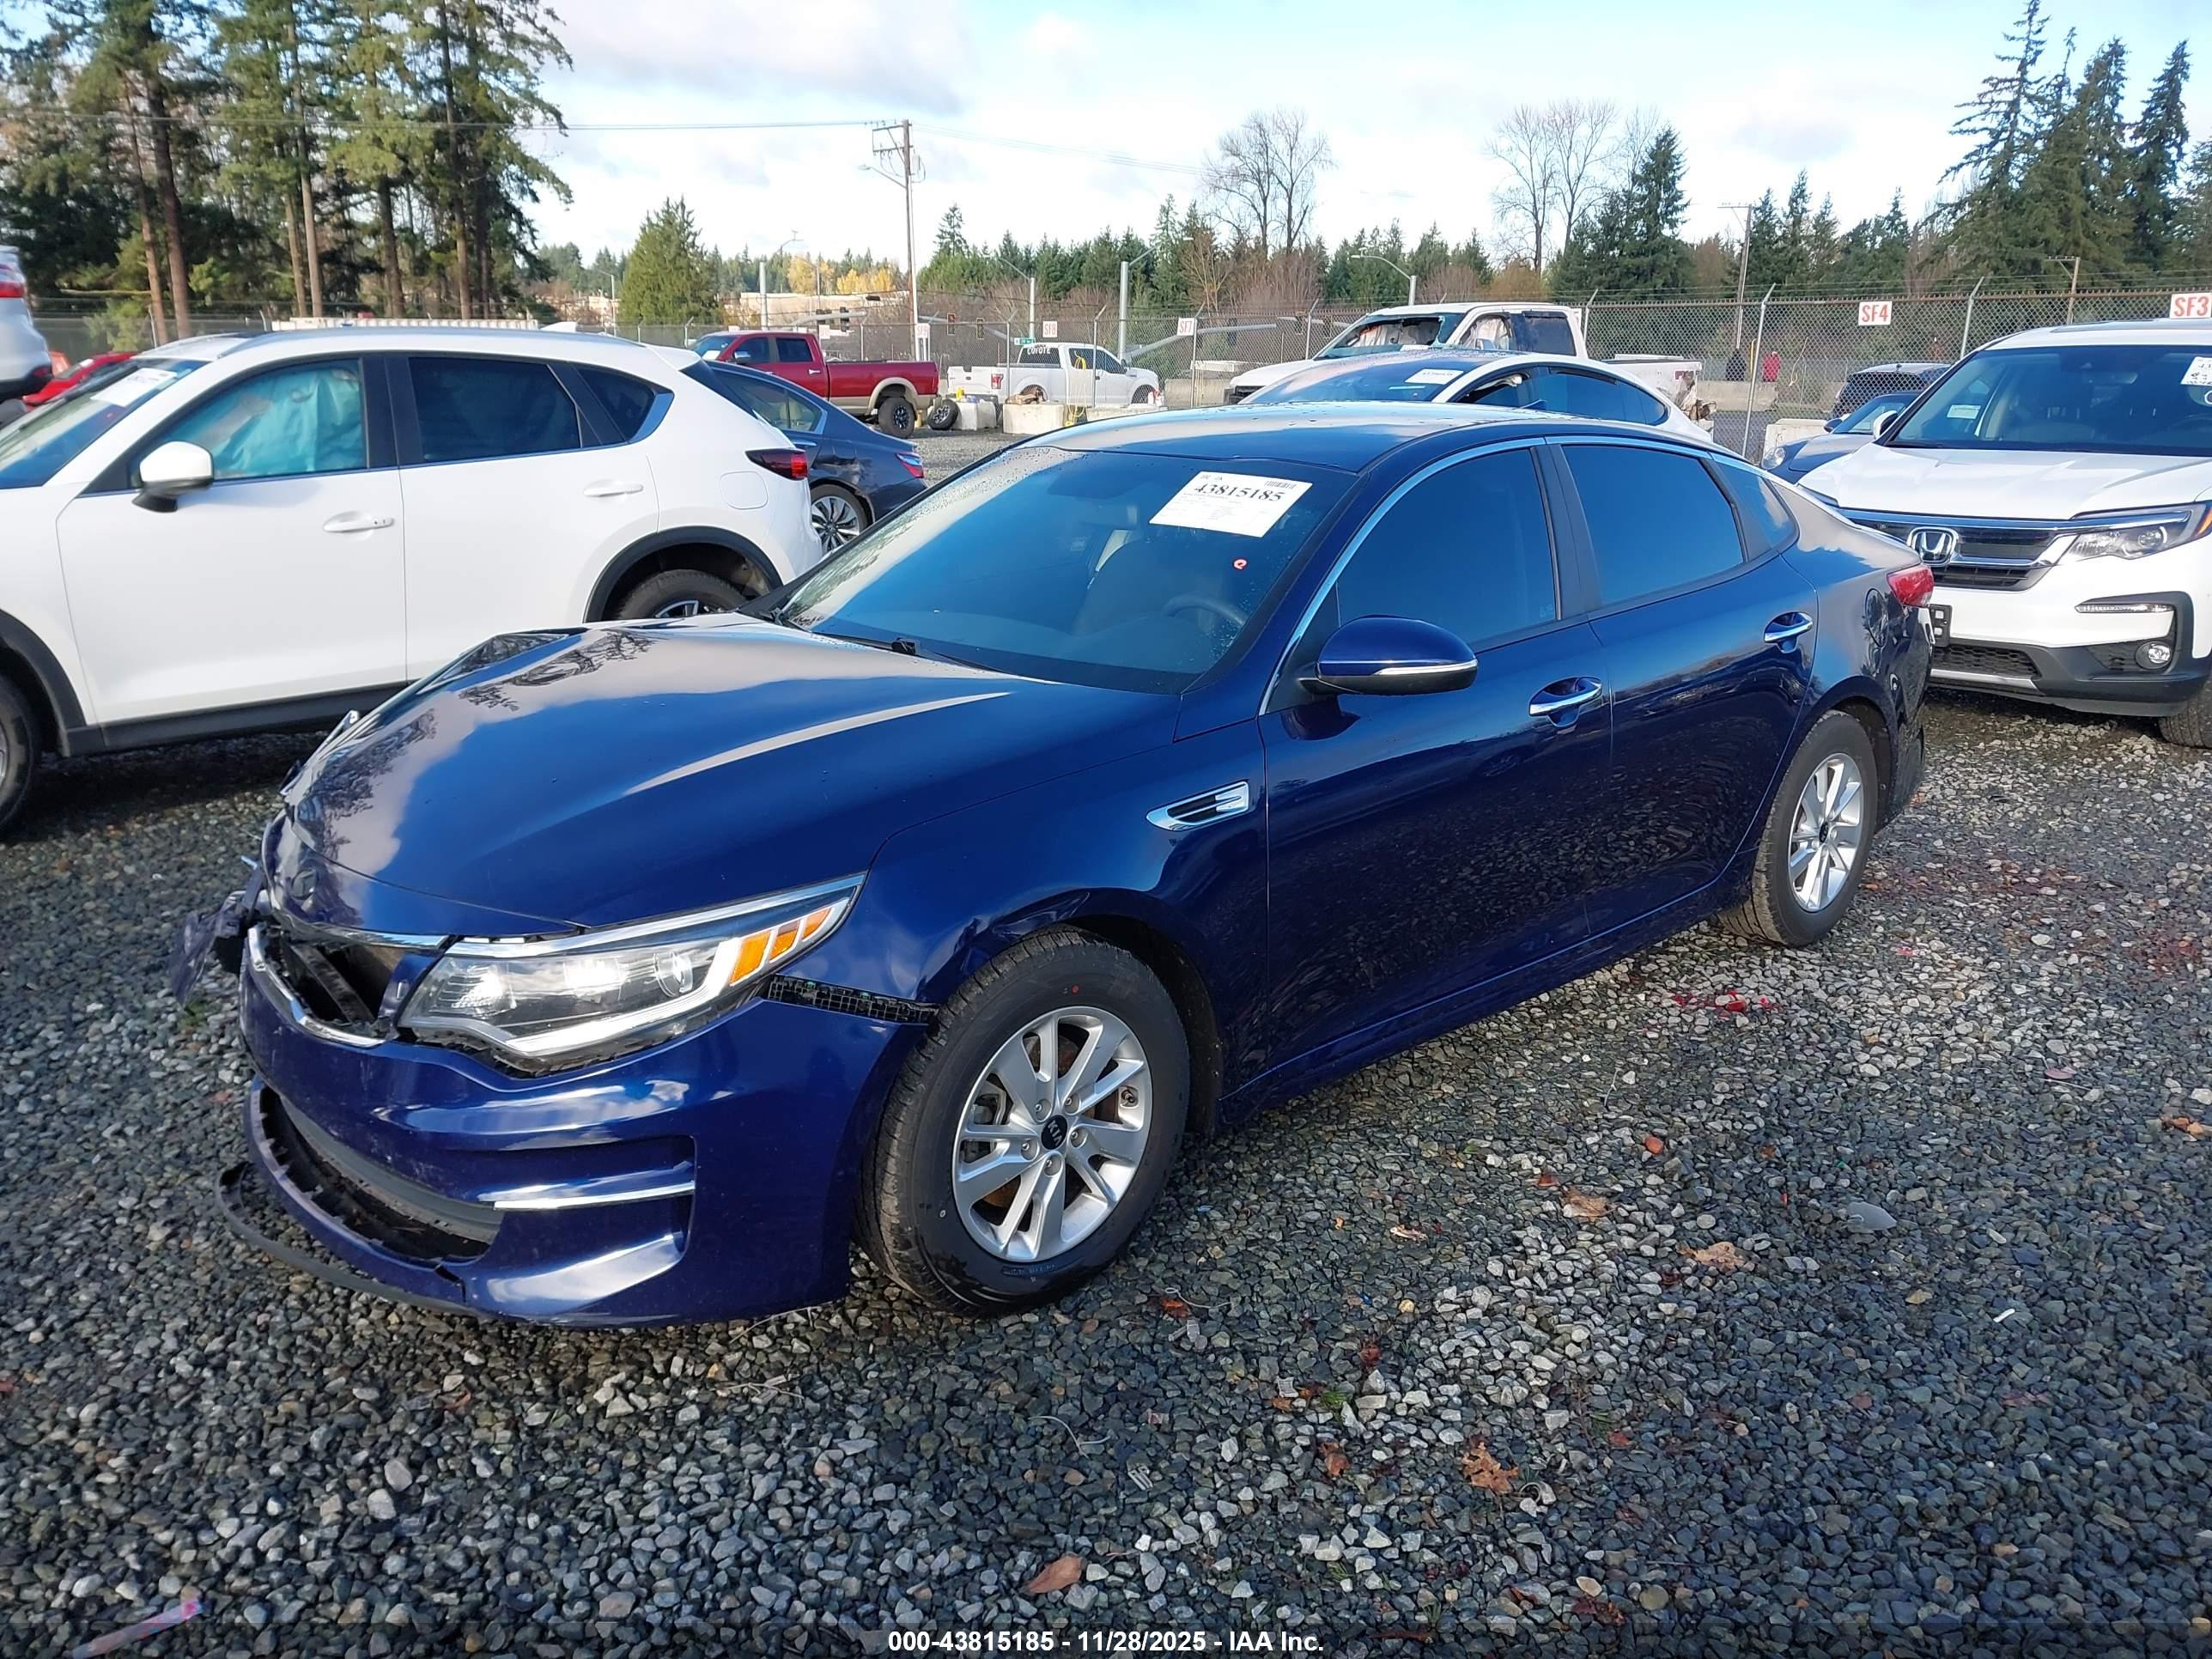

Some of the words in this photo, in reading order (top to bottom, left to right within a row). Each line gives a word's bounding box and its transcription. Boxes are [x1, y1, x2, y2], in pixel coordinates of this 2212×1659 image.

[1862, 304, 1888, 323] SF4
[2173, 296, 2209, 317] SF3
[1027, 346, 1051, 356] COYOTE
[1194, 483, 1285, 501] 43815185
[1048, 1120, 1063, 1146] KIA
